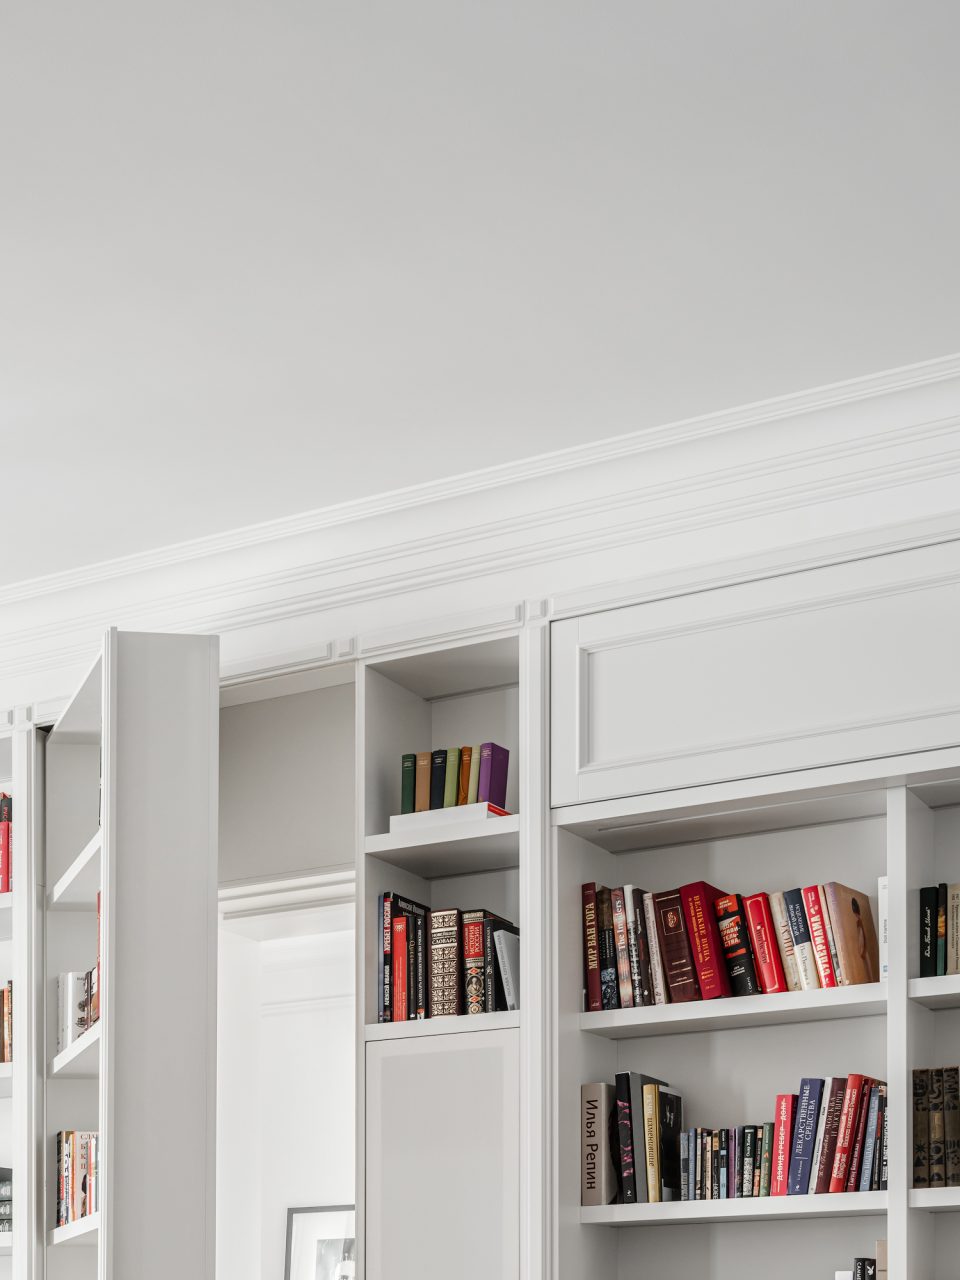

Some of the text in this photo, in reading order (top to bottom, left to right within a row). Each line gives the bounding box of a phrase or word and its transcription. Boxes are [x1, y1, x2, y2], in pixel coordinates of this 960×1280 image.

[585, 903, 598, 969] МИР ВАН ГОГА
[614, 900, 626, 951] The Insiders
[693, 895, 710, 961] ВЕЛИКИЕ ВИНА
[586, 1099, 598, 1189] Илья Репин
[647, 1117, 655, 1166] изменившие
[795, 1085, 810, 1155] ЛЕКАРСТВЕННЫЕ
[804, 1100, 816, 1141] СРЕДСТВА
[776, 1156, 785, 1181] ДЭВИД
